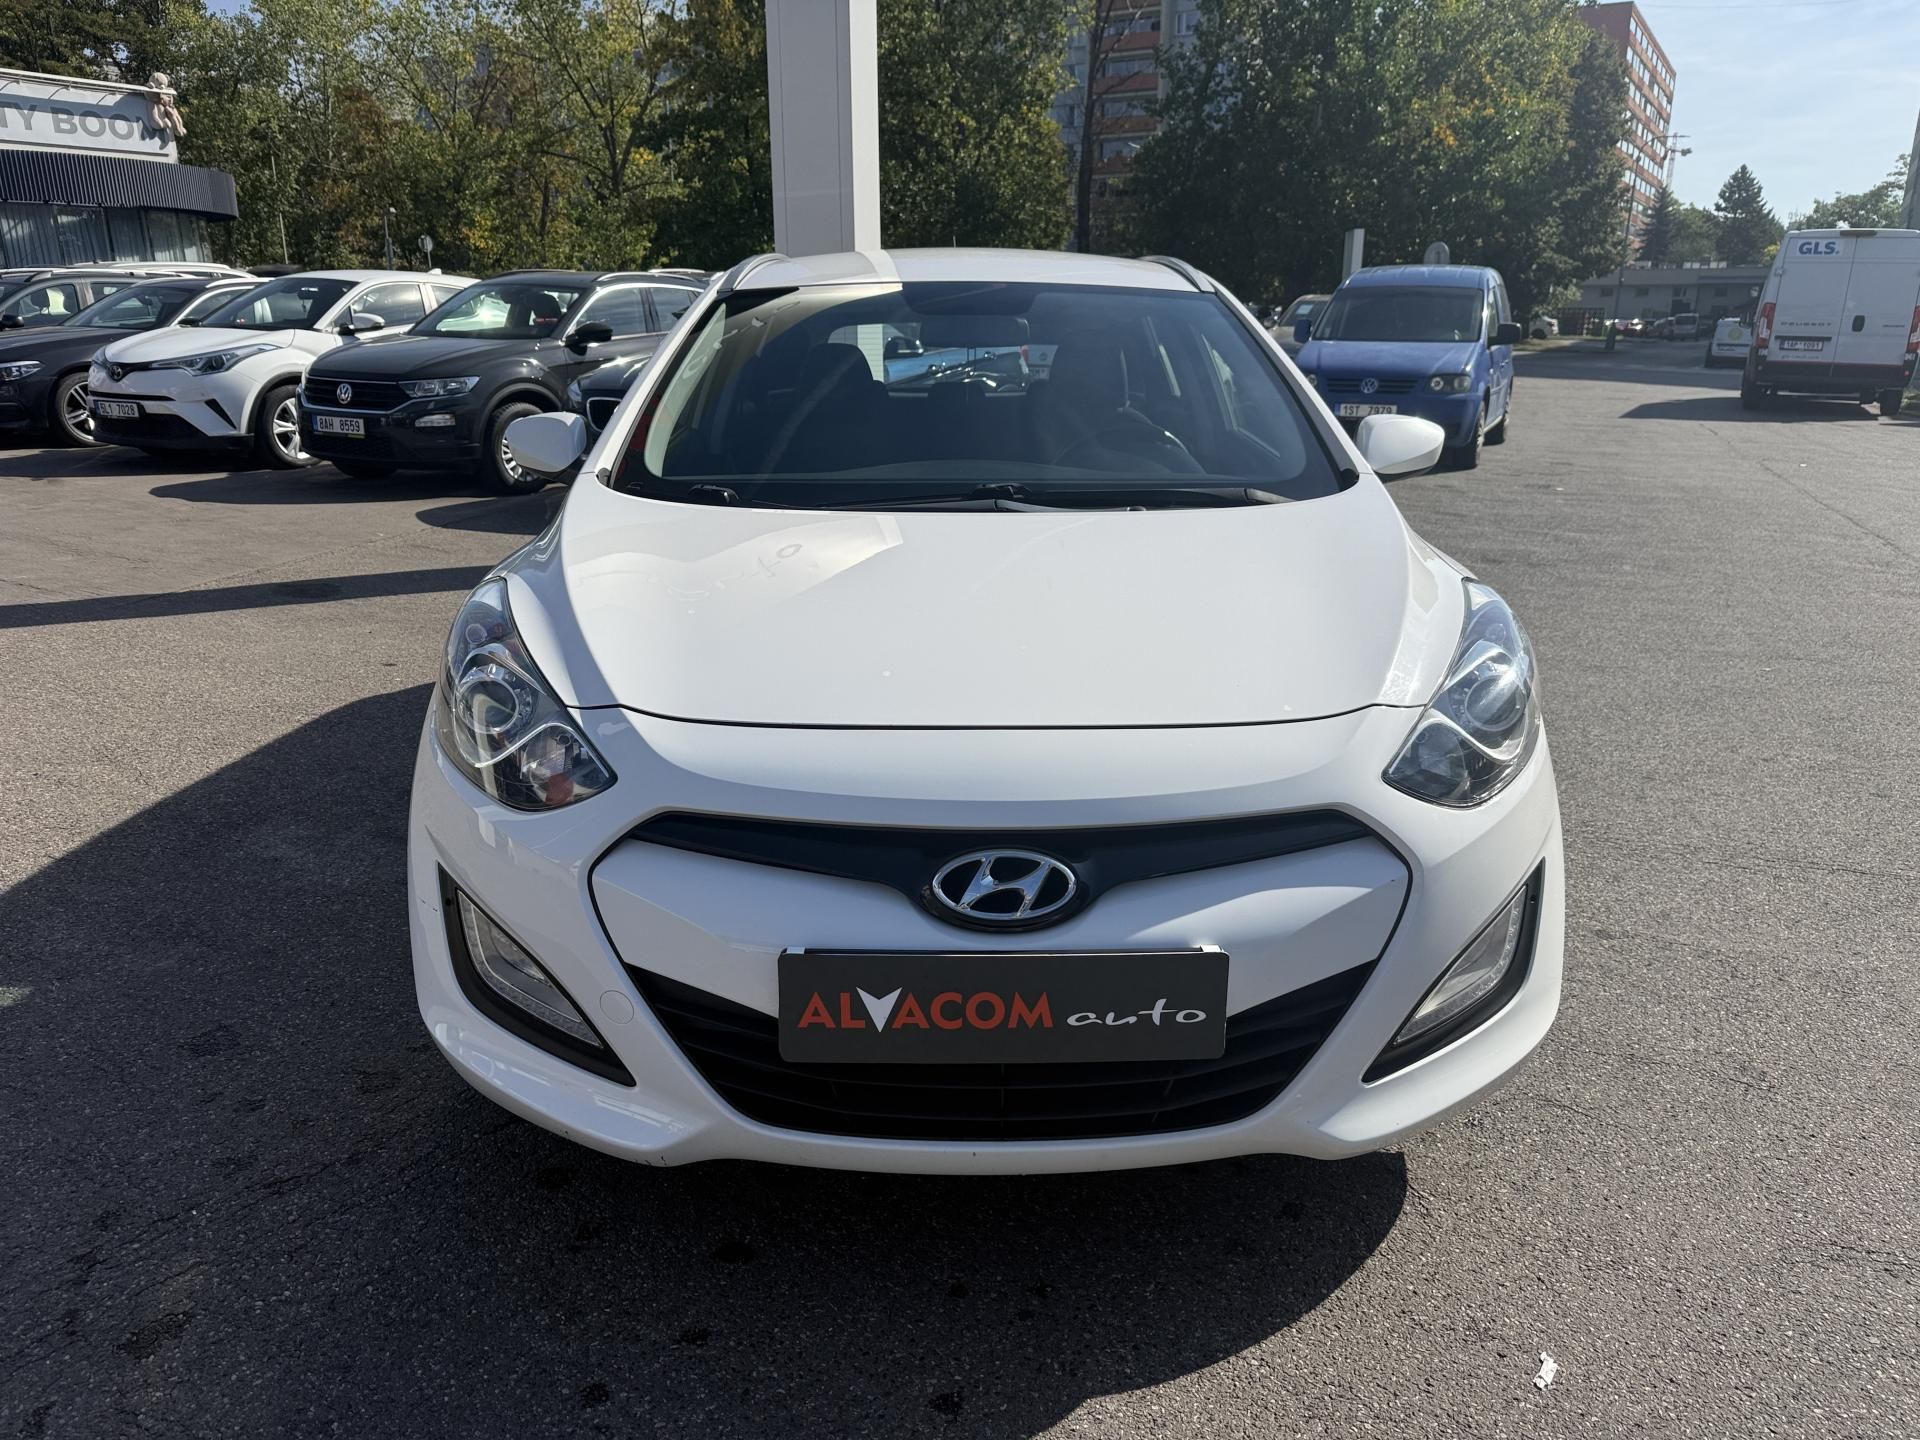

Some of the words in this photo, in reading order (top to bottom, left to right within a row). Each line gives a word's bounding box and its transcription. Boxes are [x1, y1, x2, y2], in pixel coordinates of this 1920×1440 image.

[1343, 405, 1360, 416] 1ST
[319, 417, 334, 430] 8AH
[340, 419, 360, 432] 8559
[797, 986, 1054, 1033] ALVACOM
[1066, 998, 1207, 1027] auto
